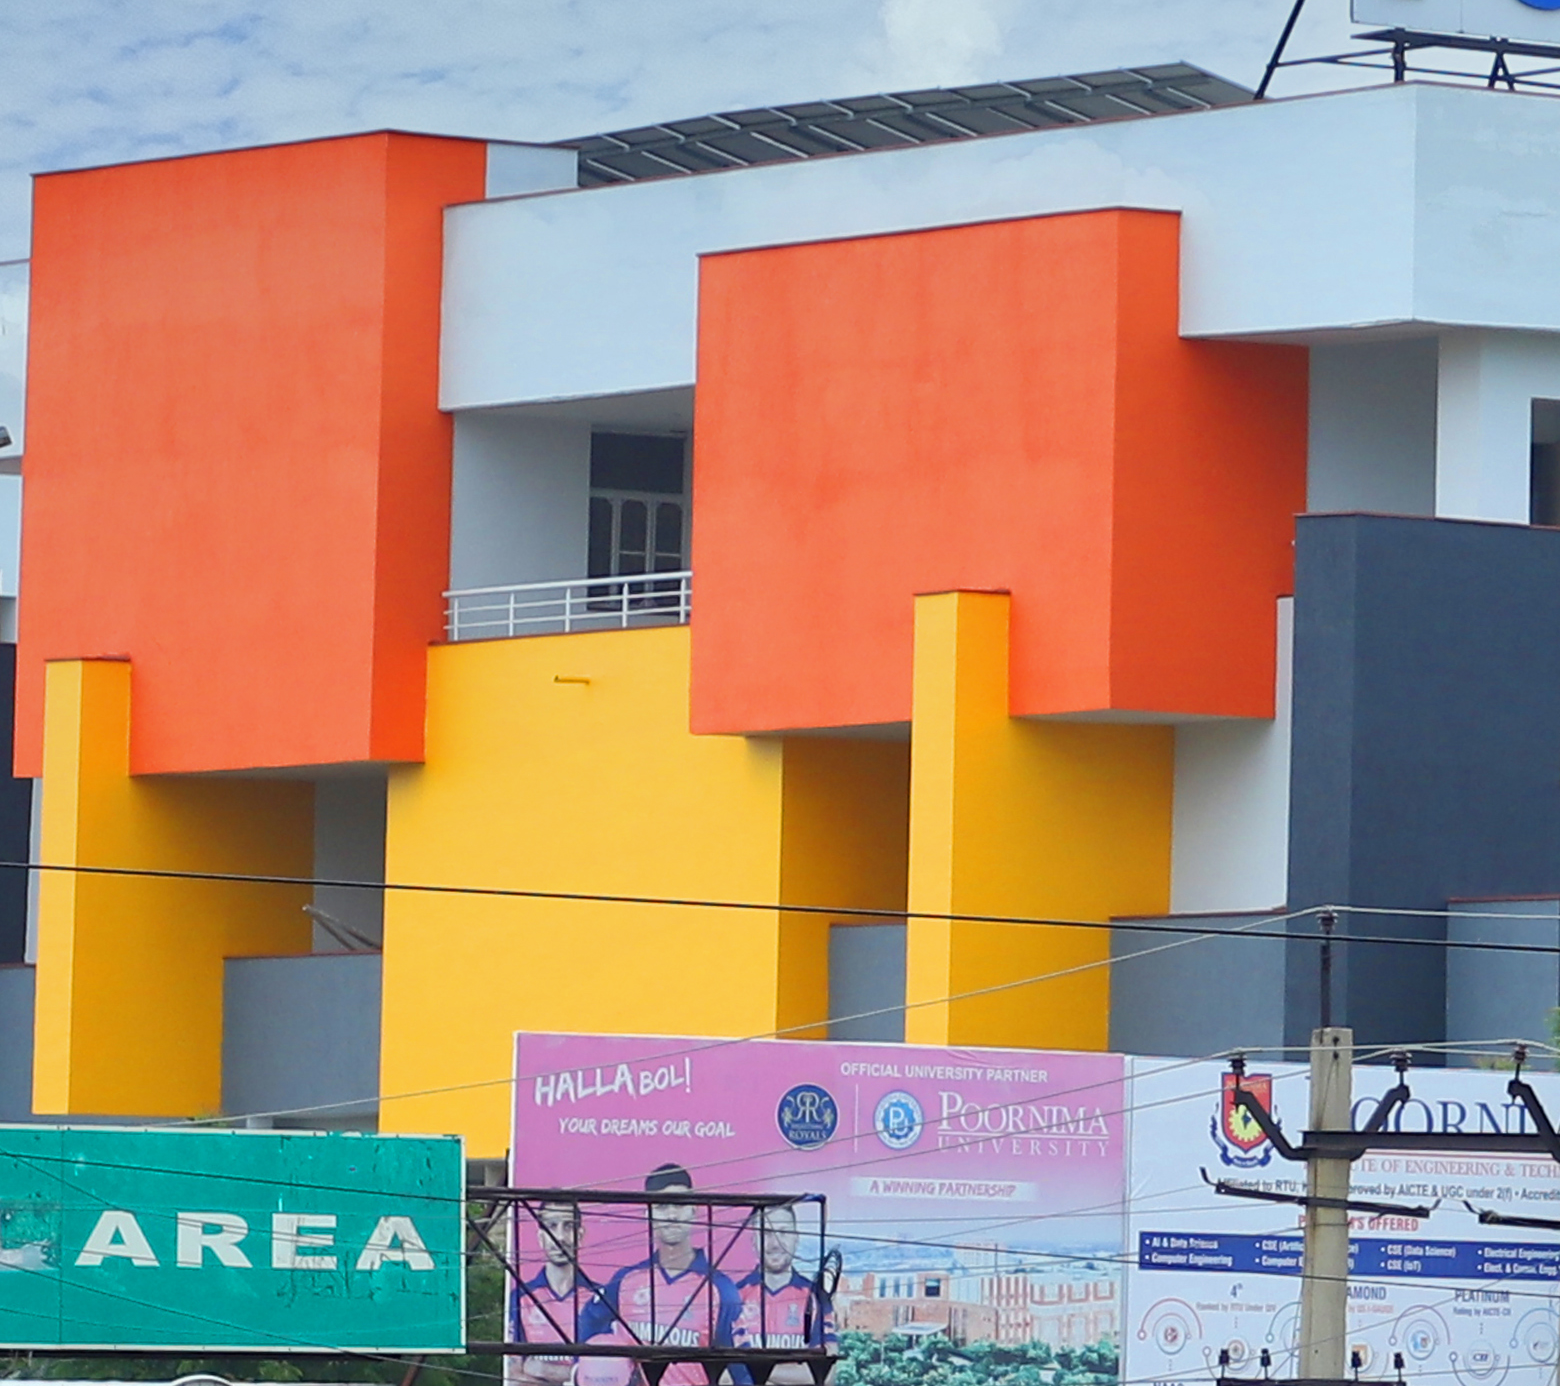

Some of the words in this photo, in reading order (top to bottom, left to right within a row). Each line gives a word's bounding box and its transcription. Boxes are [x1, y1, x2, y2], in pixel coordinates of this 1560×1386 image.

[534, 1063, 638, 1107] HALLA
[639, 1057, 691, 1096] BOL!
[841, 1062, 901, 1077] OFFICIAL
[905, 1064, 984, 1081] UNIVERSITY
[986, 1067, 1048, 1083] PARTNER
[938, 1091, 1110, 1135] POORNIMA
[558, 1117, 598, 1136] YOUR
[601, 1118, 658, 1137] DREAMS
[662, 1119, 692, 1138] OUR
[694, 1120, 736, 1138] GOAL
[937, 1137, 1110, 1157] UNIVERSITY
[1381, 1158, 1400, 1174] OF
[1405, 1160, 1500, 1178] ENGINEERING
[1503, 1163, 1516, 1177] &
[870, 1180, 879, 1194] A
[882, 1181, 935, 1195] WINNING
[939, 1182, 1017, 1198] PARTNERSHIP
[1398, 1184, 1430, 1197] AICTE
[1441, 1185, 1464, 1199] UGC
[1466, 1186, 1494, 1199] under
[1368, 1217, 1419, 1232] OFFERED
[74, 1210, 436, 1272] AREA
[1454, 1289, 1510, 1304] PLATINUM
